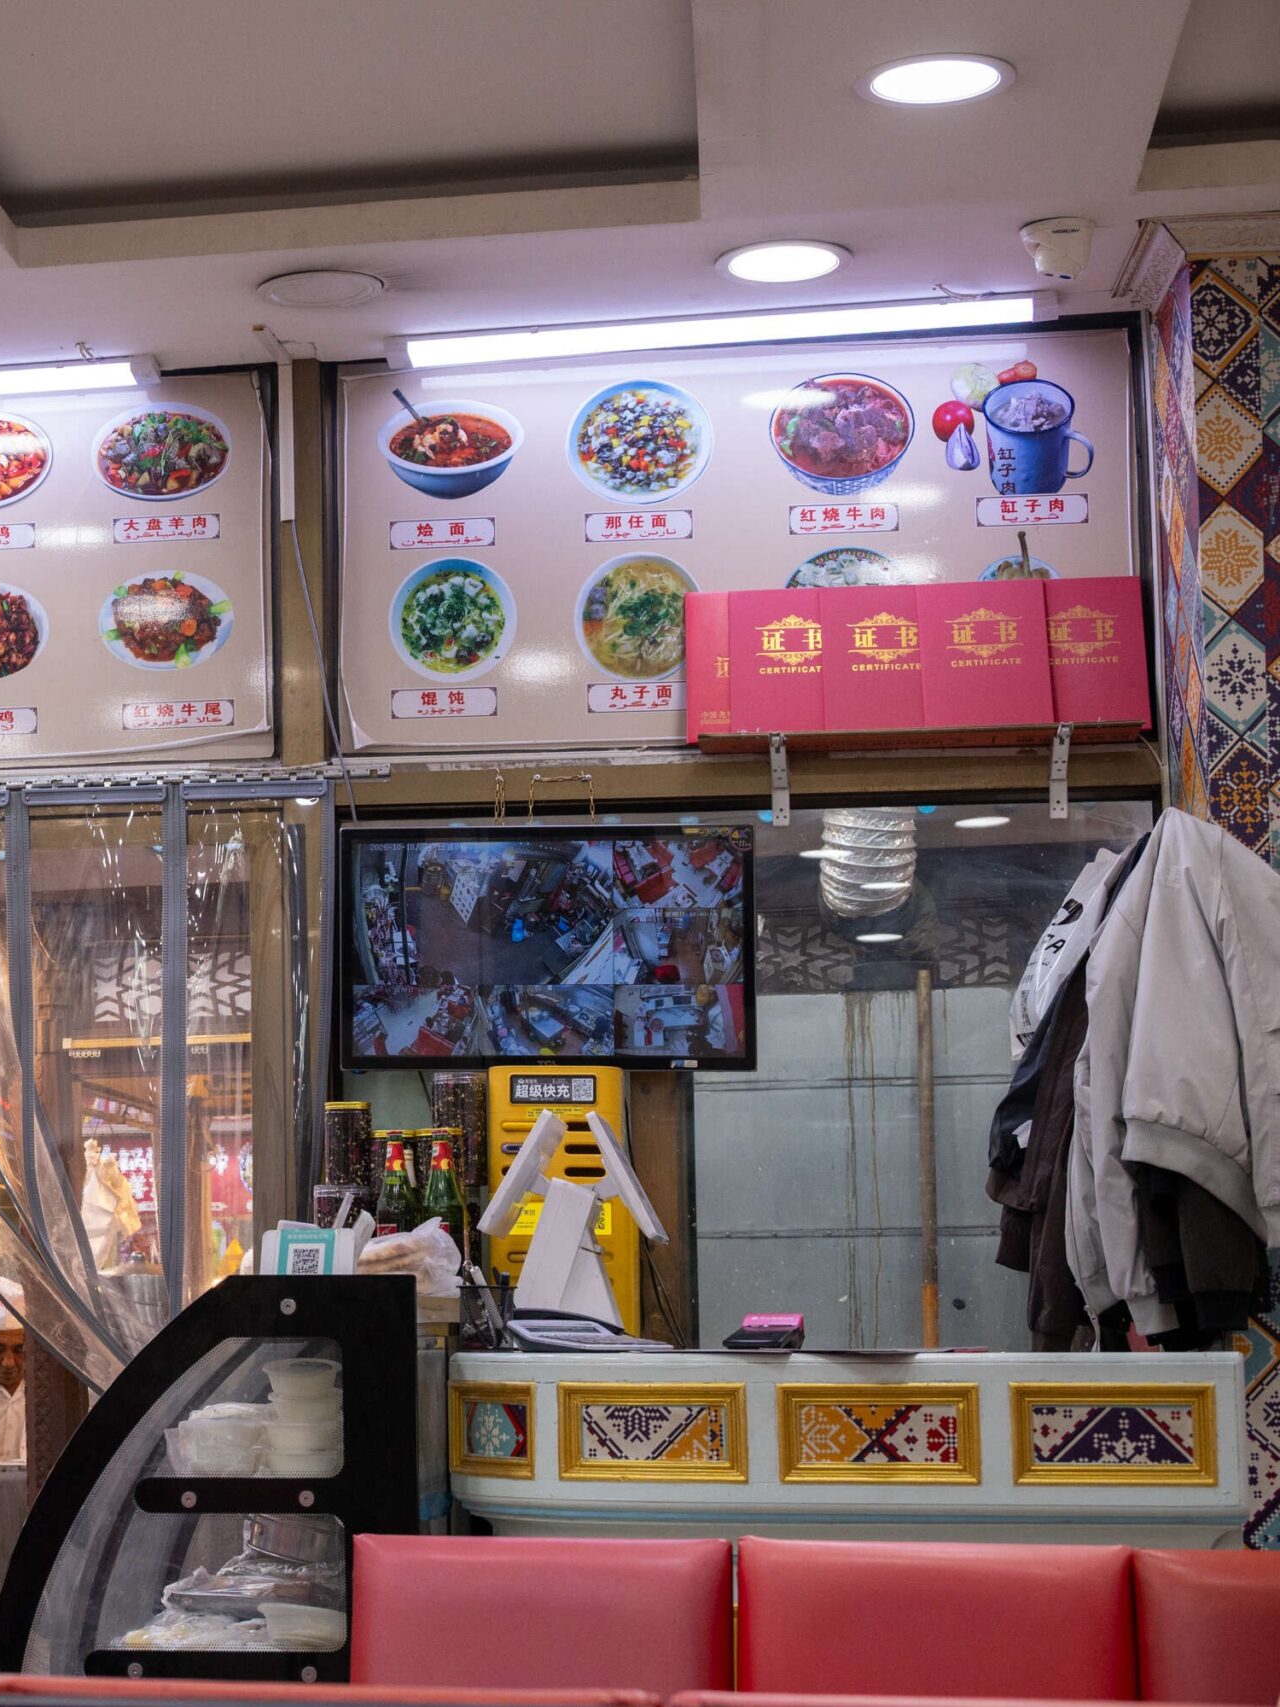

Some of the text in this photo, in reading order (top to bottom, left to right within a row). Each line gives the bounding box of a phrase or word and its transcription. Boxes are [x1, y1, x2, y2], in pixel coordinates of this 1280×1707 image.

[997, 448, 1016, 495] 缸子肉
[1001, 498, 1064, 513] 缸子肉
[606, 514, 667, 529] 那任面
[800, 507, 885, 521] 红烧牛肉
[124, 516, 207, 531] 大盘羊肉
[417, 522, 464, 536] 烩面
[852, 626, 918, 648] 证书
[951, 623, 1018, 645] 证书
[1049, 619, 1115, 642] 证书
[762, 629, 822, 651] 证书
[759, 664, 822, 675] CERTIFICAT
[951, 657, 1022, 668] CERTIFICATE
[420, 690, 464, 705] 馄饨
[611, 684, 672, 699] 丸子面
[133, 701, 222, 717] 红烧牛尾
[515, 1084, 570, 1098] 超级快充
